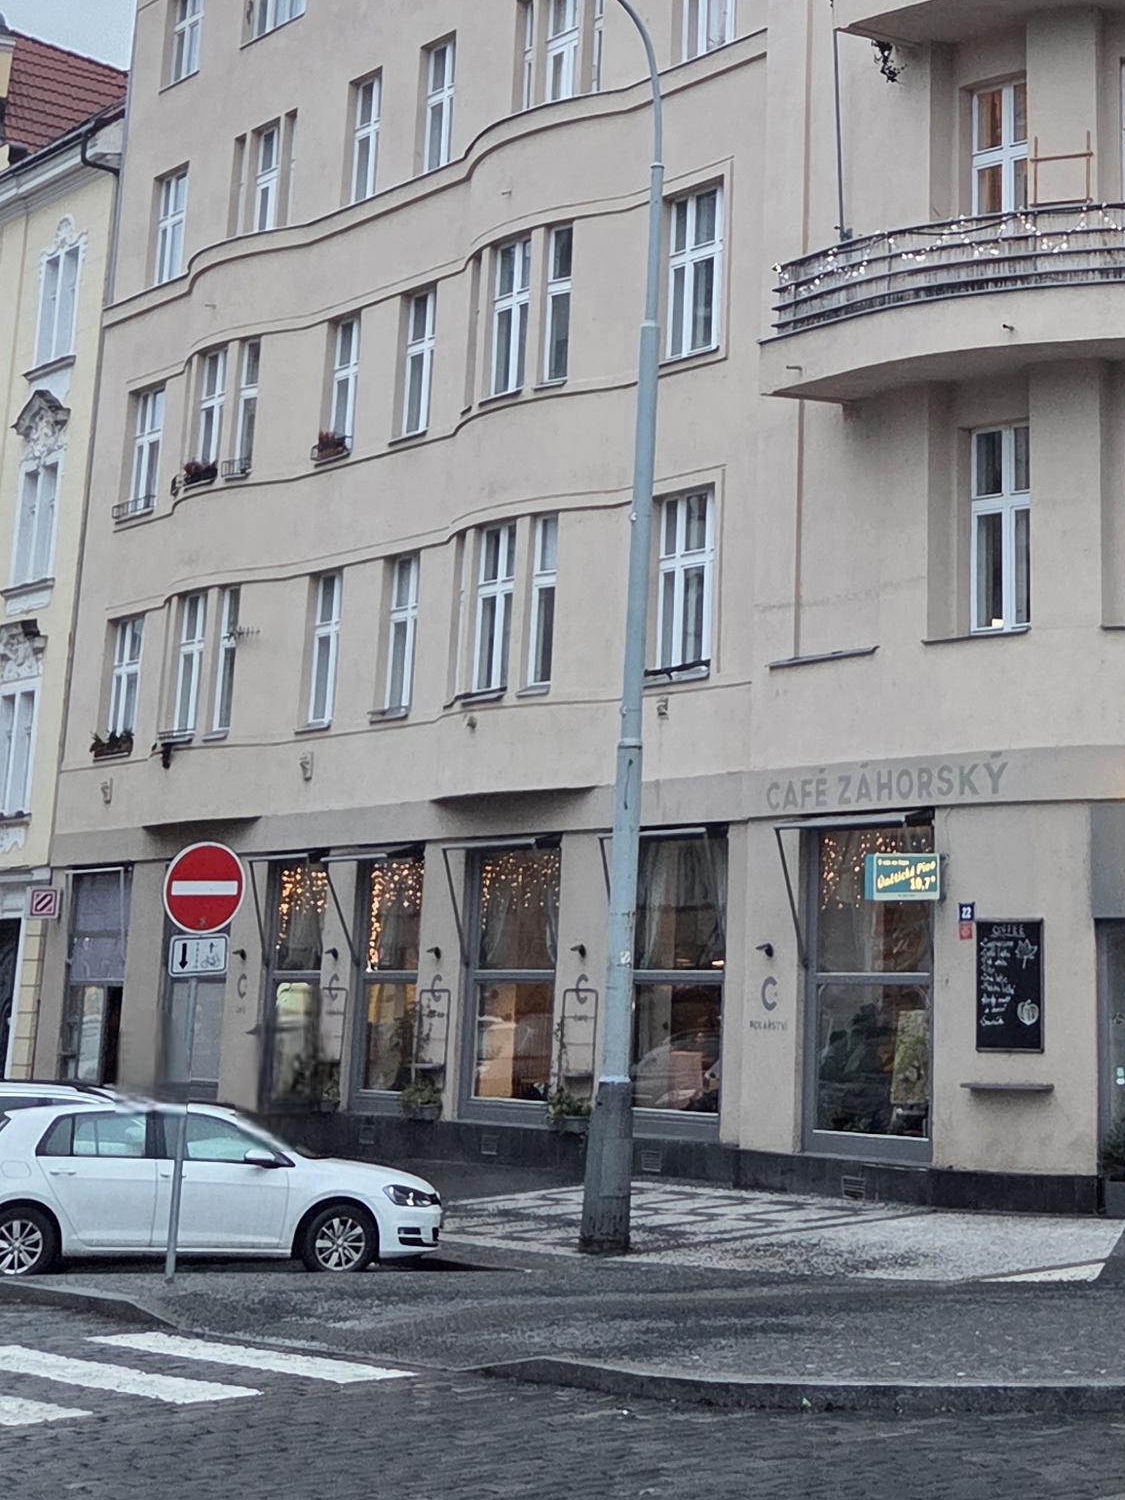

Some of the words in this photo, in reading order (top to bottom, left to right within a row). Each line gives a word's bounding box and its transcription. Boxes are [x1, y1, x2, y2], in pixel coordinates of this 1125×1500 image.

[766, 767, 827, 811] CAFÉ
[837, 751, 1009, 805] ZÁHORSKÝ
[961, 906, 972, 919] 22
